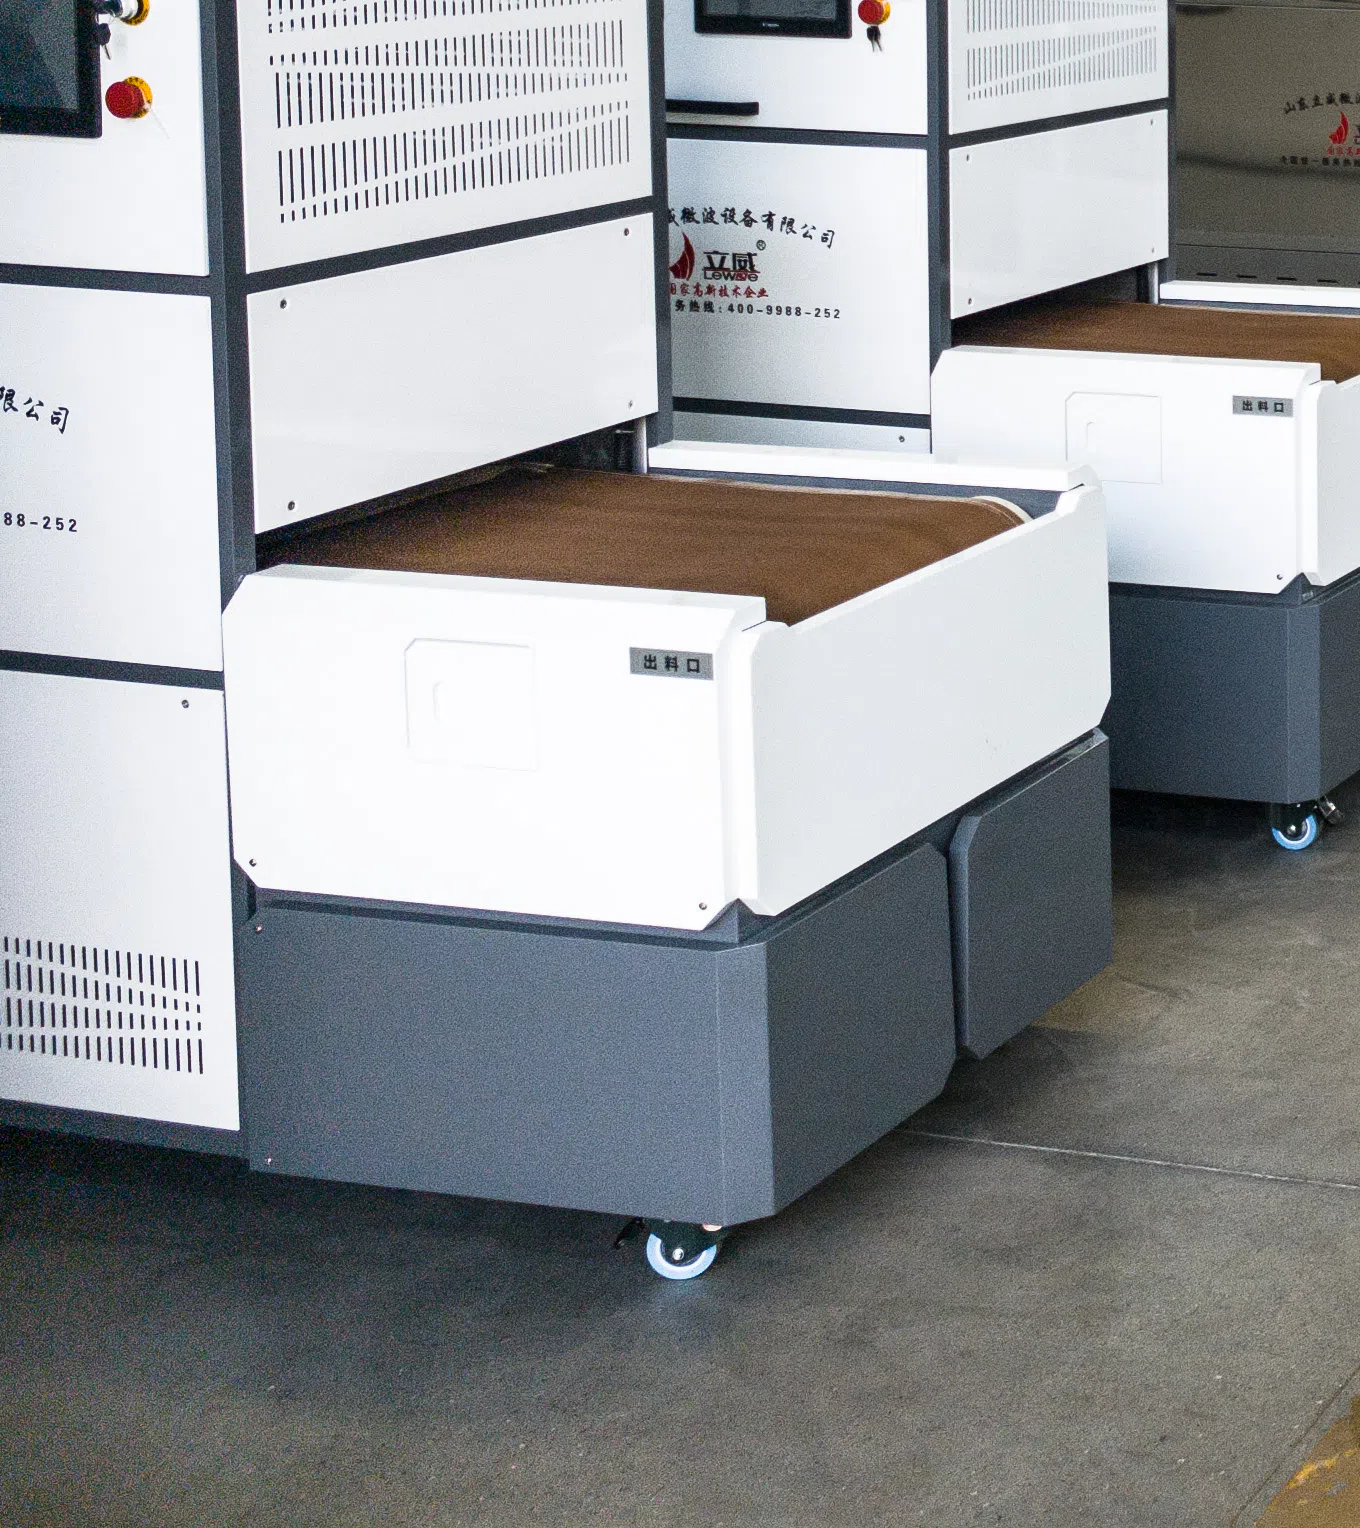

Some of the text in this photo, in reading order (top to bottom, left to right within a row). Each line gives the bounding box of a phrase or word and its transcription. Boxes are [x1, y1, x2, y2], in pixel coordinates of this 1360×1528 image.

[702, 250, 758, 271] 立威
[0, 385, 70, 435] 限公司
[1242, 399, 1285, 413] 出料口
[3, 511, 78, 532] 88-252
[643, 654, 700, 673] 出料口
